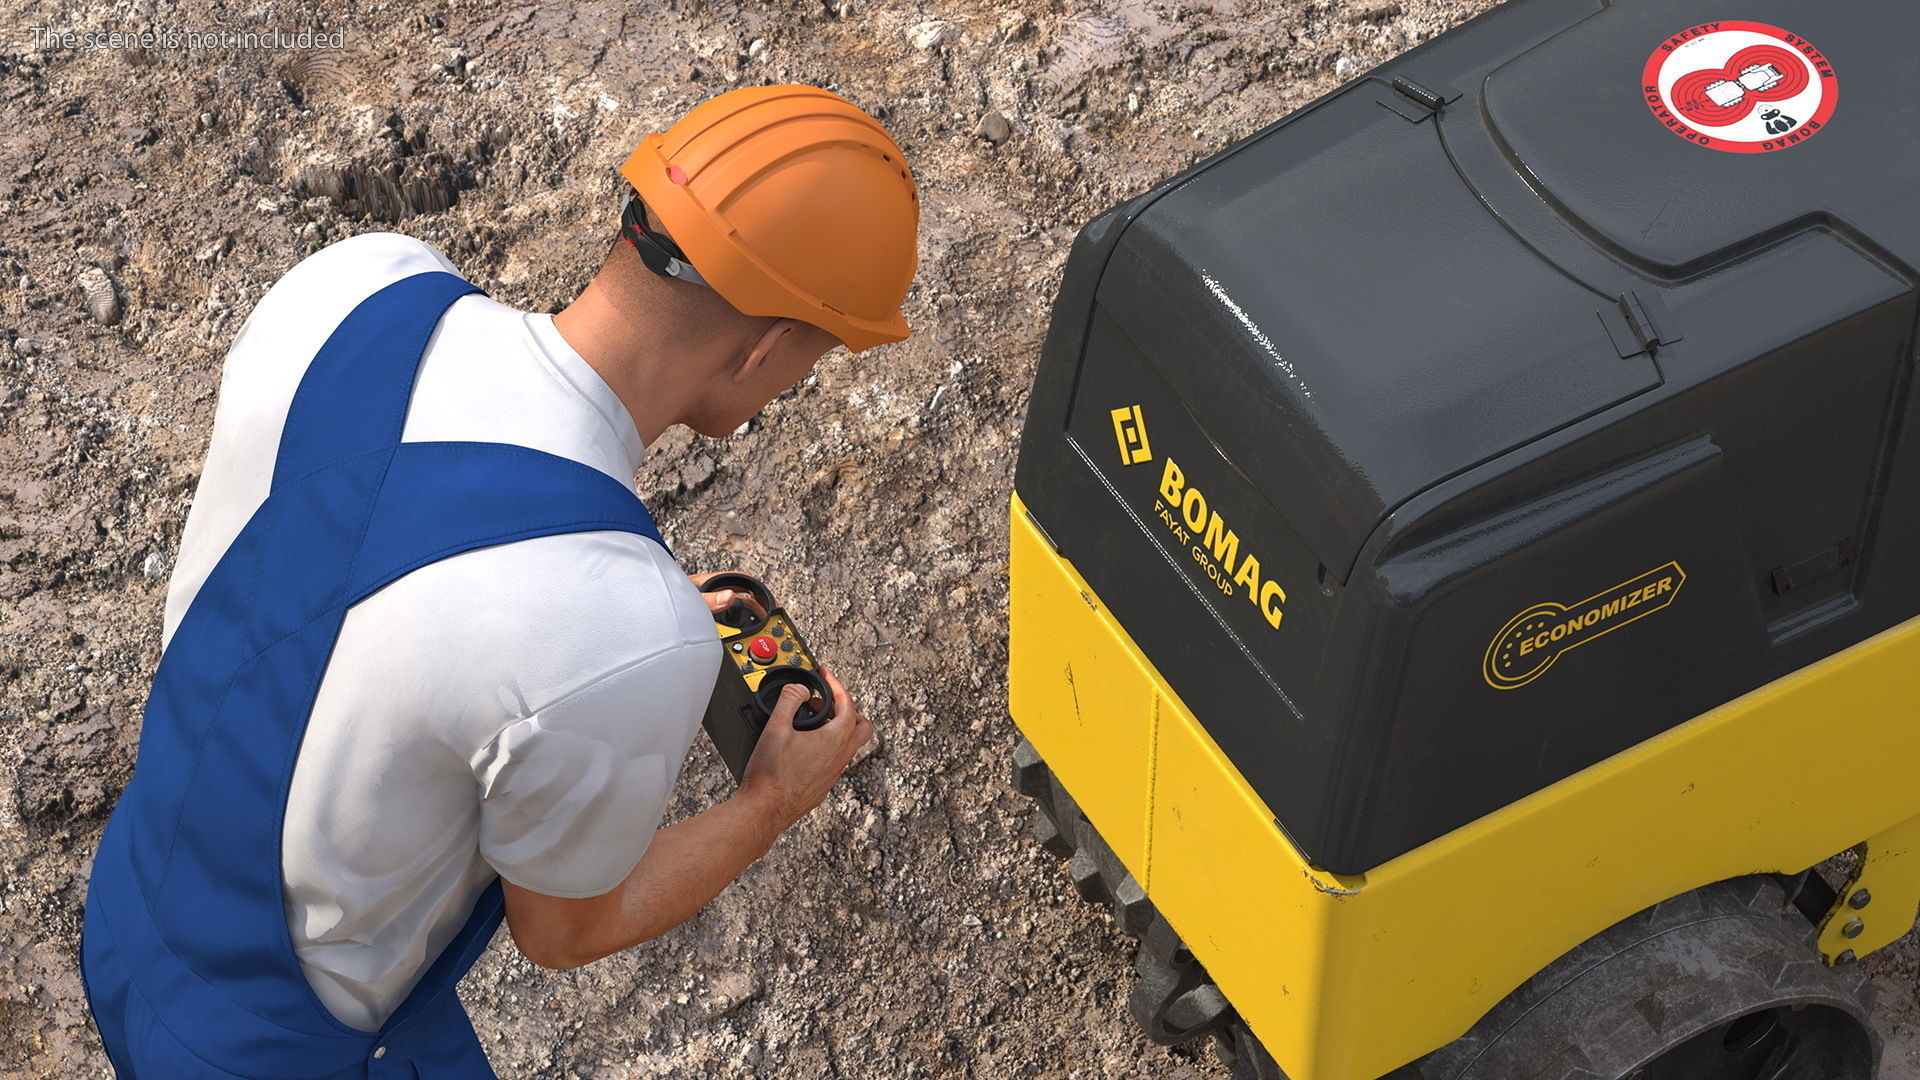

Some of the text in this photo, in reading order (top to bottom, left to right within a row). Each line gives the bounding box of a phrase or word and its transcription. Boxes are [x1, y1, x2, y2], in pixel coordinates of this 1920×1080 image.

[1645, 22, 1834, 151] BOMAG OPERATOR SAFETY SYSTEM
[1154, 500, 1234, 596] FAYAT GROUP
[1159, 456, 1287, 631] BOMAG
[758, 638, 770, 652] STOP
[1519, 576, 1673, 657] ECONOMIZER
